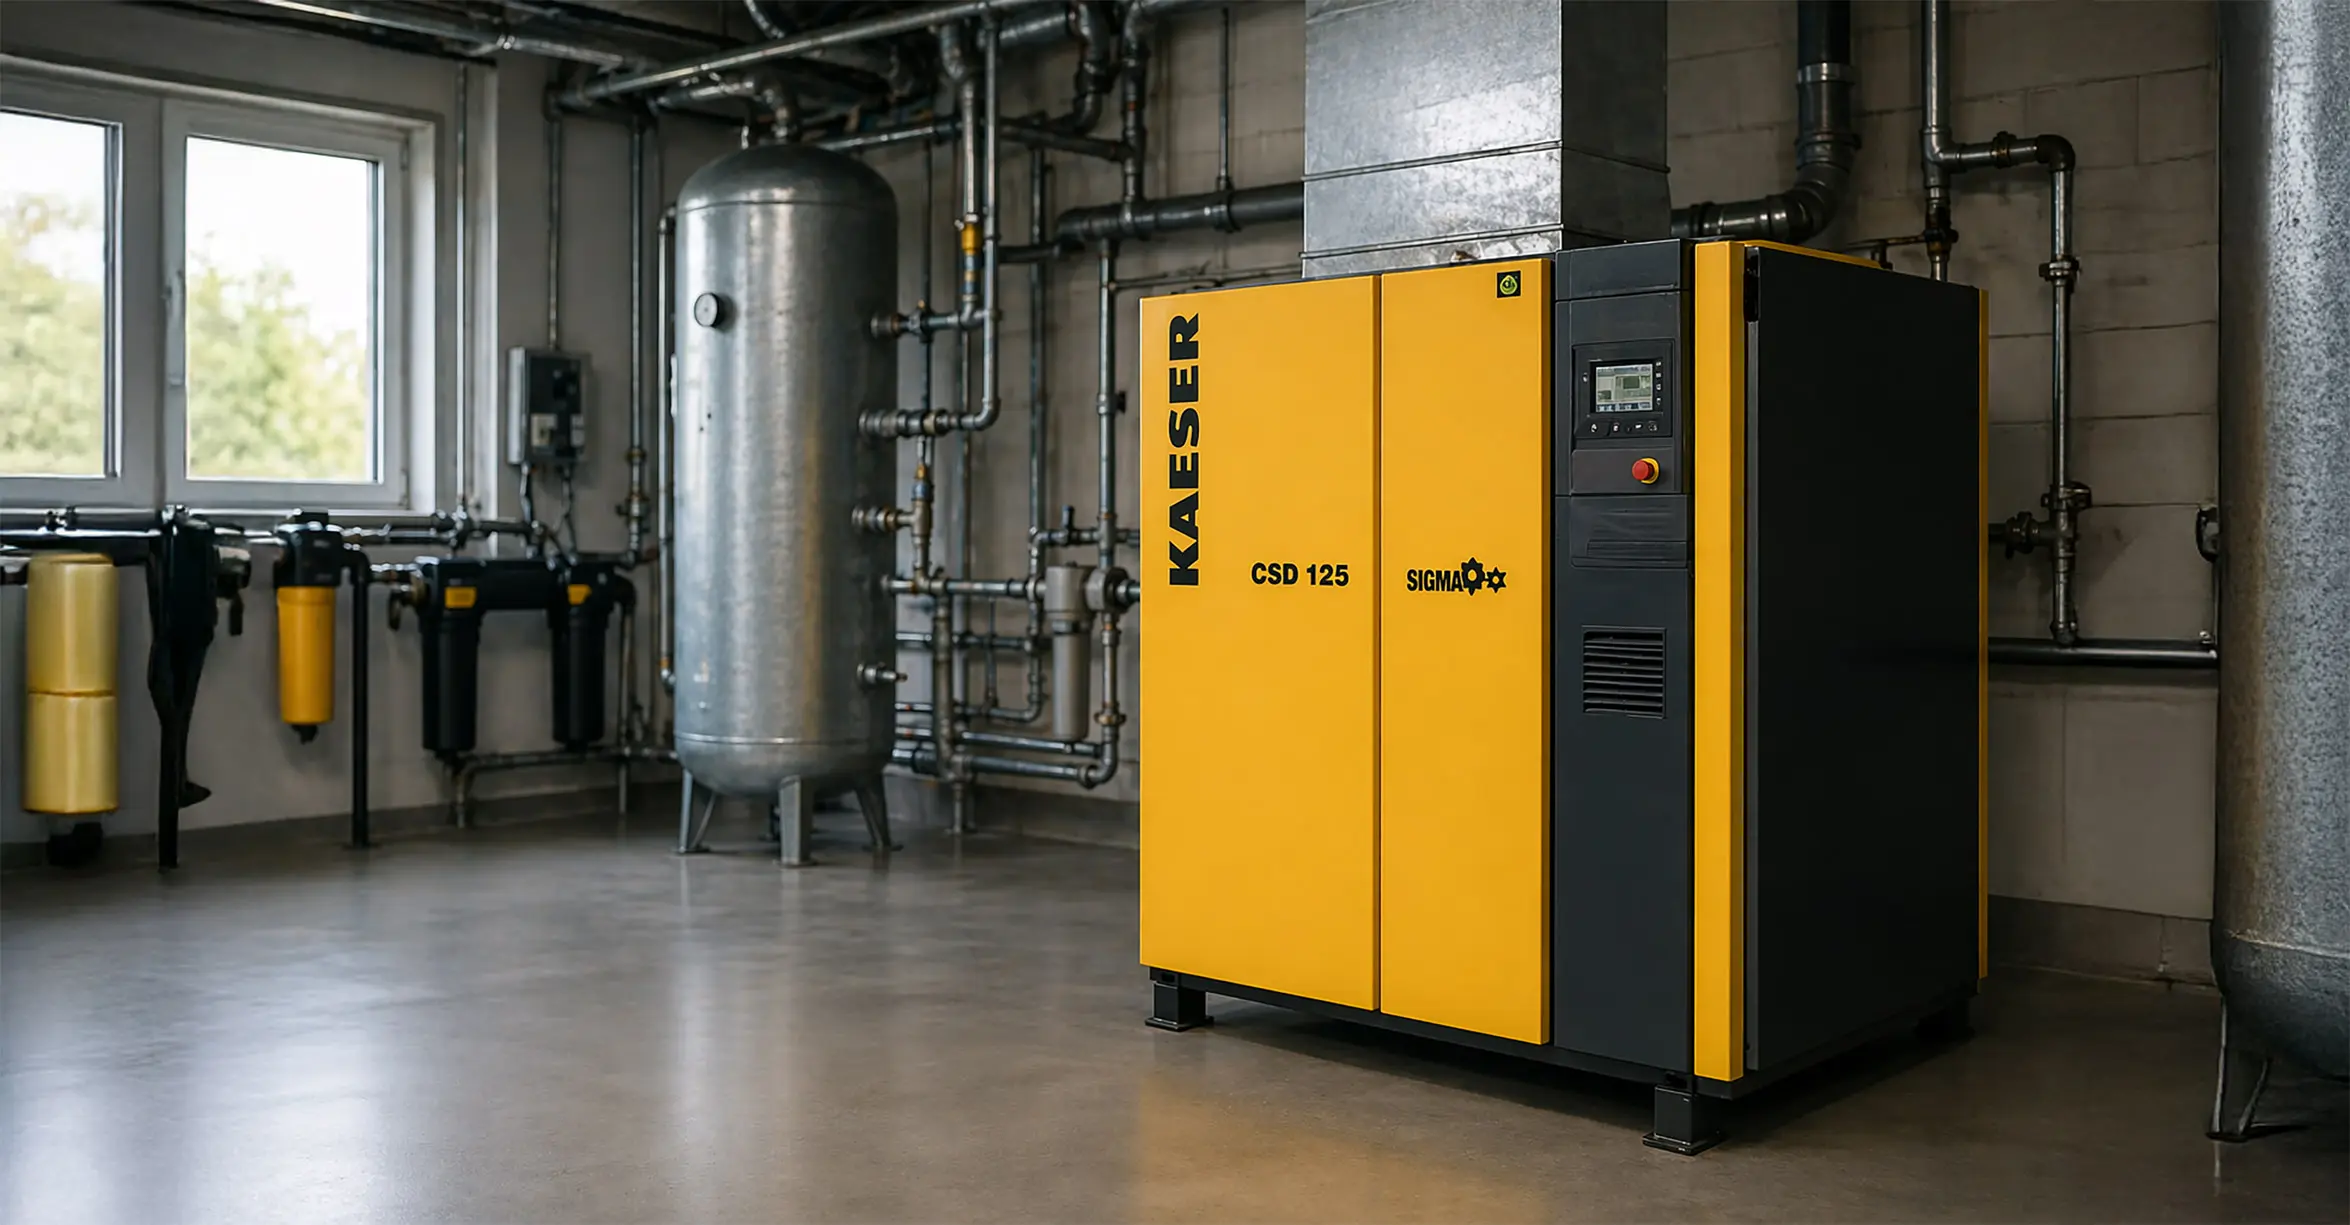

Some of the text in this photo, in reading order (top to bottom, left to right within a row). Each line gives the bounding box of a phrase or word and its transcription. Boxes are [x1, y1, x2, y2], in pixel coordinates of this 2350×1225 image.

[1168, 313, 1200, 586] KAESER
[1251, 562, 1349, 586] CSD 125
[1406, 568, 1463, 593] SIGMA
